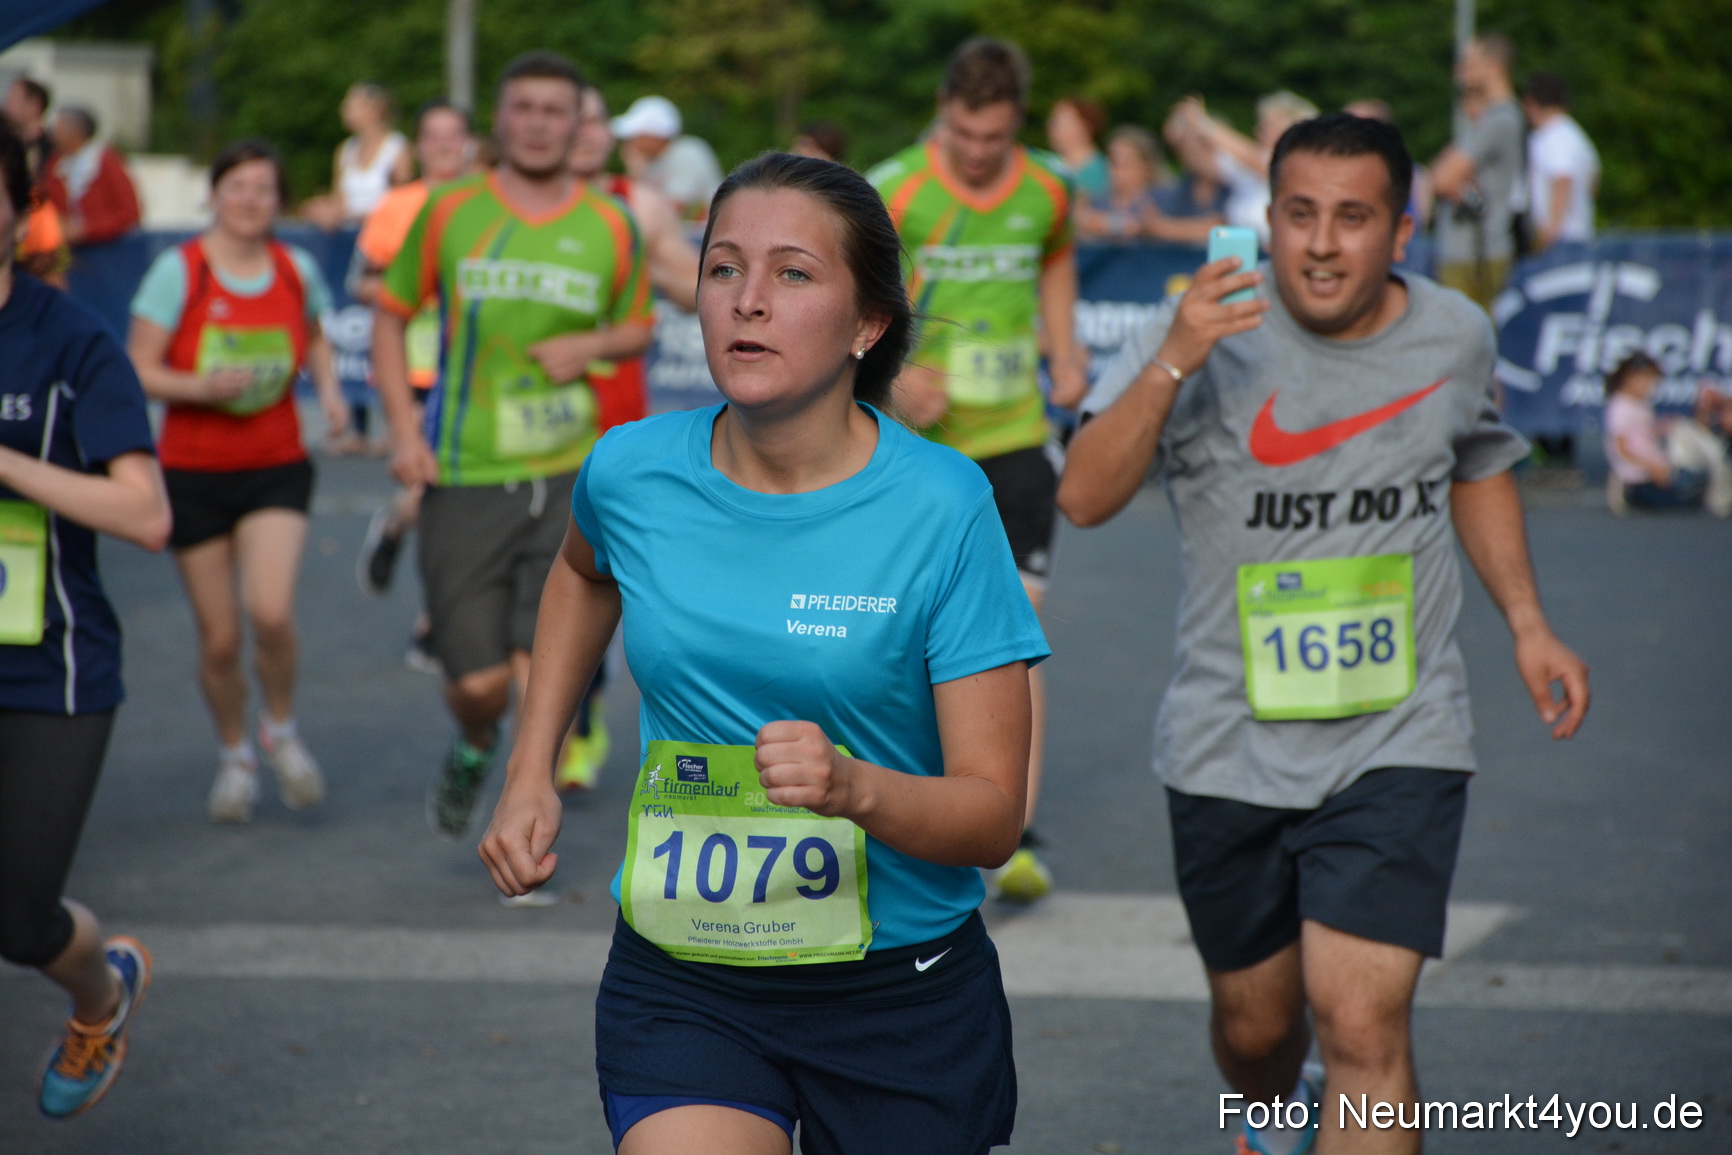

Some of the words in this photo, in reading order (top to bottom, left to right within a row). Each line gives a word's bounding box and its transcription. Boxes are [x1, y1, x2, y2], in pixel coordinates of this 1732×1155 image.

[0, 392, 33, 421] ES
[1246, 490, 1337, 531] JUST
[1349, 486, 1402, 525] DO
[807, 594, 897, 614] PFLEIDERER
[786, 619, 847, 638] Verena
[1263, 617, 1396, 674] 1658
[663, 777, 741, 797] firmenlauf
[653, 831, 840, 903] 1079
[691, 919, 741, 934] Verena
[743, 920, 796, 935] Gruber
[688, 936, 722, 947] Pfleiderer
[722, 938, 778, 949] Holzwerkstoffe
[779, 938, 804, 946] GmbH
